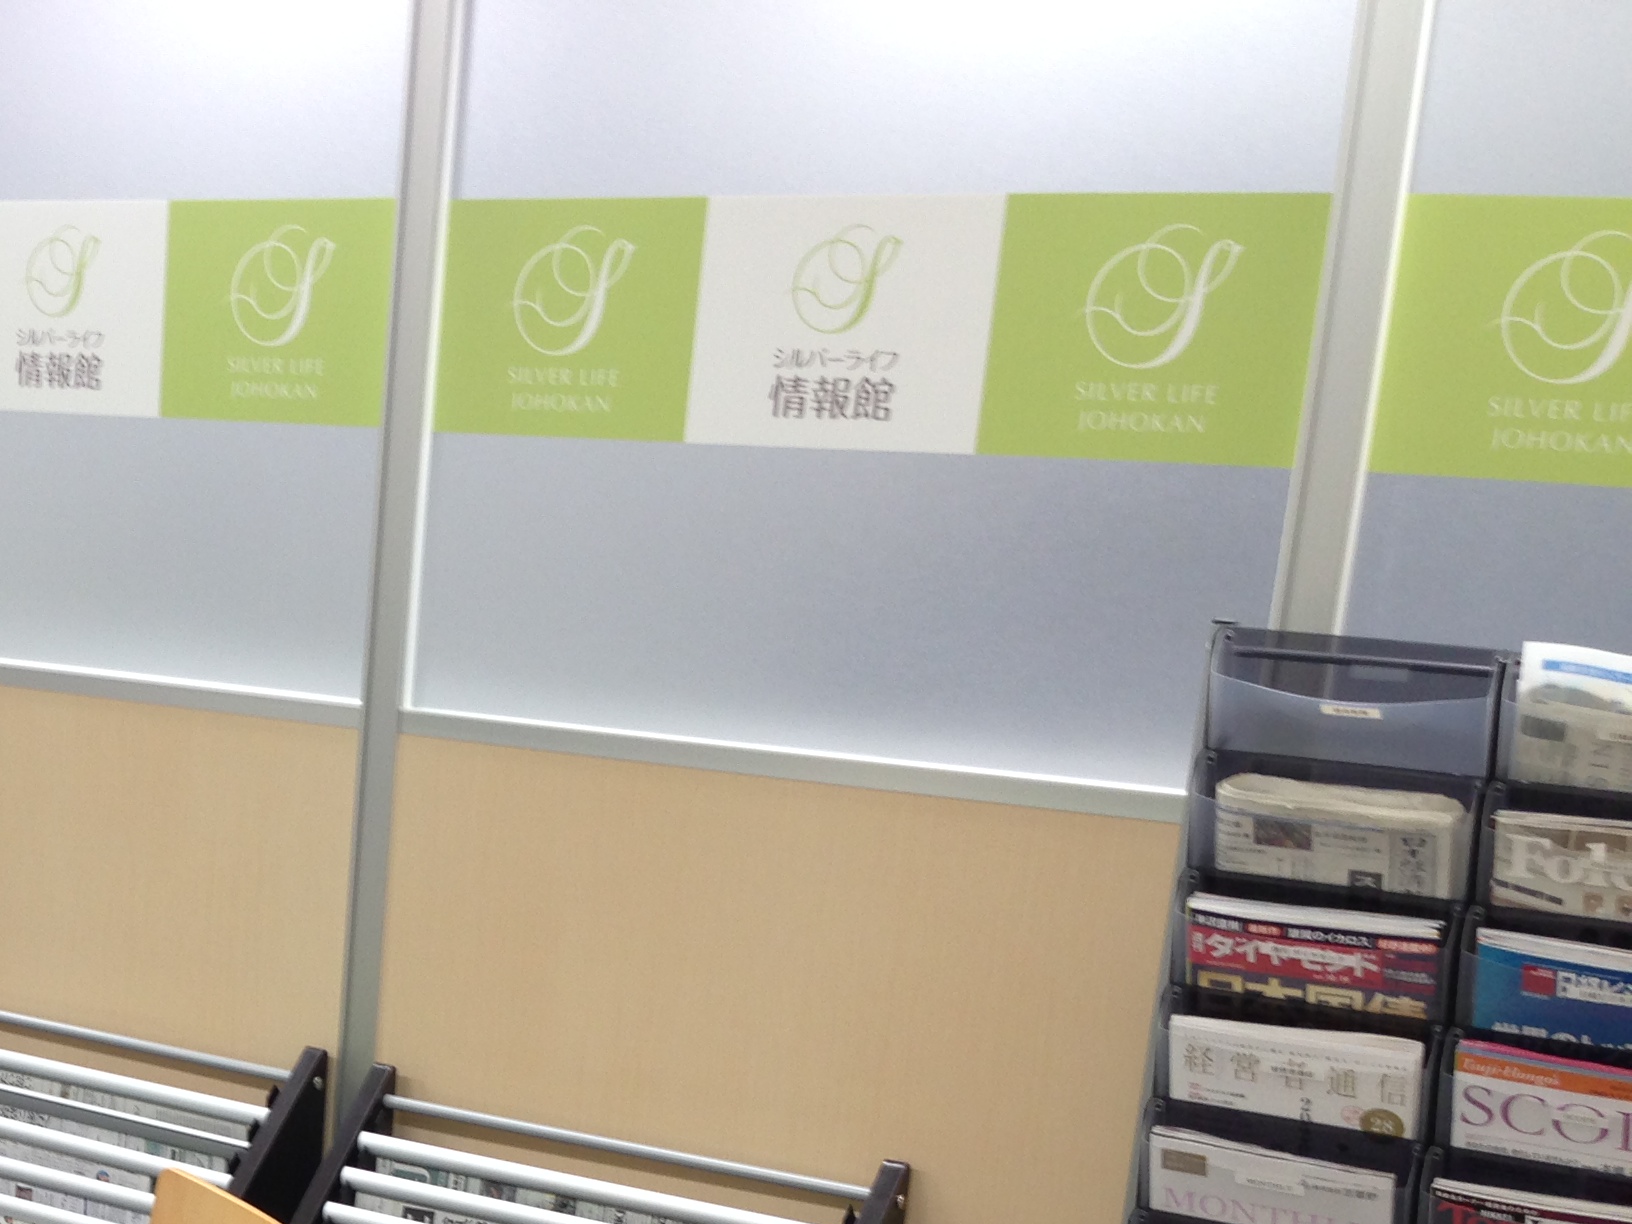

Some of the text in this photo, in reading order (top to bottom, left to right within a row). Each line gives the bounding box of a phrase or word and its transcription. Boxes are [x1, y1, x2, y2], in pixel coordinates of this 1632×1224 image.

[15, 328, 105, 348] シルバーライフ
[14, 350, 102, 391] 情報館
[227, 356, 325, 378] SILVER LIFE
[772, 347, 899, 371] シルバーライフ
[507, 366, 621, 388] SILVER LIFE
[229, 380, 319, 400] JOHOKAN
[511, 391, 613, 413] JOHOKAN
[769, 374, 896, 421] 情報館
[1074, 380, 1220, 405] SILVER LIFE
[1487, 396, 1582, 421] SILVER
[1077, 409, 1207, 434] JOHOKAN
[1491, 427, 1632, 454] JOHOKAN
